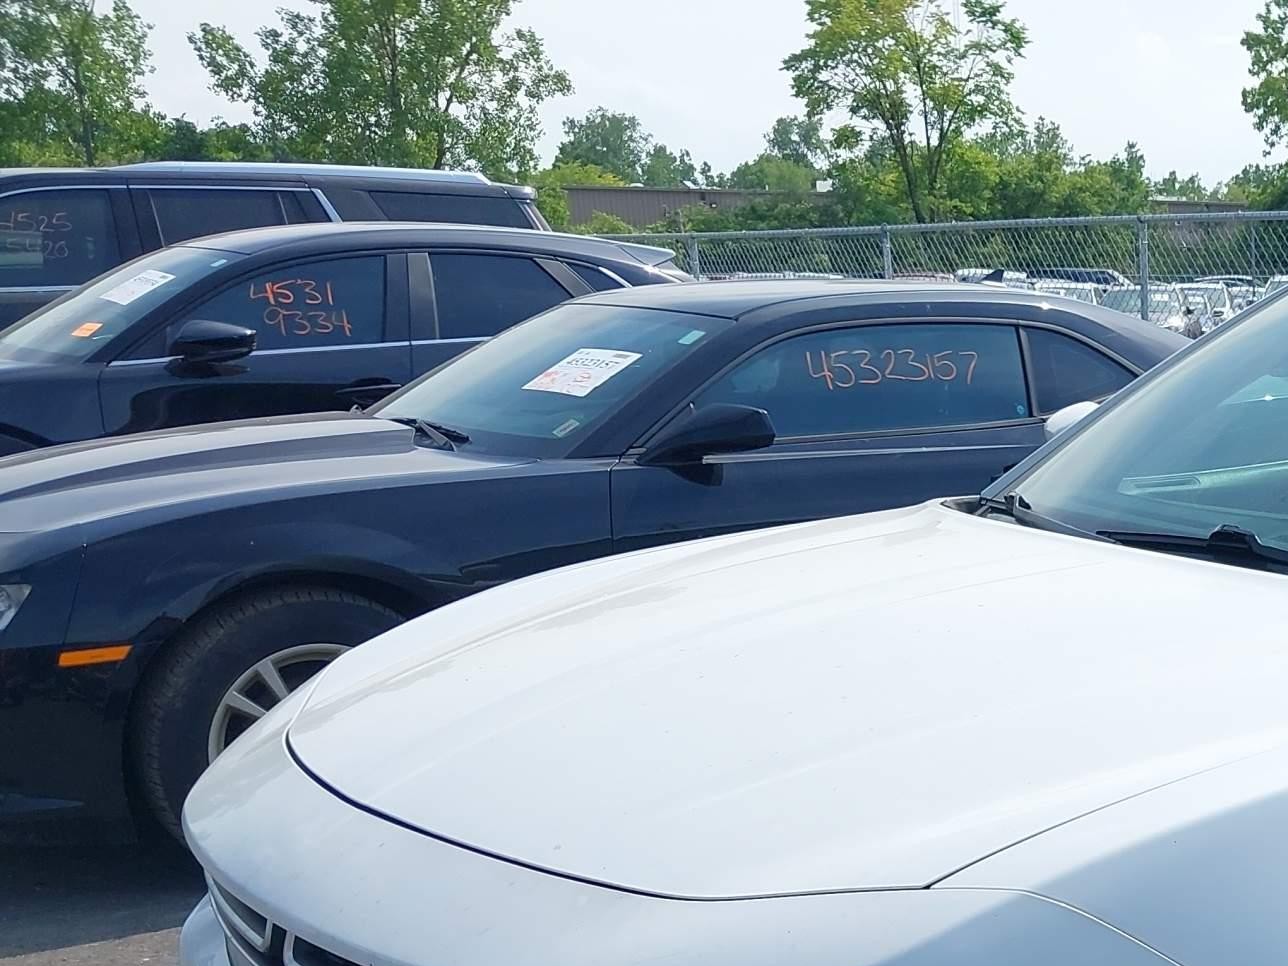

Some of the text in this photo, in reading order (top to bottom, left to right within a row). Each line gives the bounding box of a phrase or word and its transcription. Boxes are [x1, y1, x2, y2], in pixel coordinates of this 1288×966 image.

[249, 279, 334, 306] 4531
[263, 306, 353, 337] 9334
[805, 349, 978, 391] 45323157
